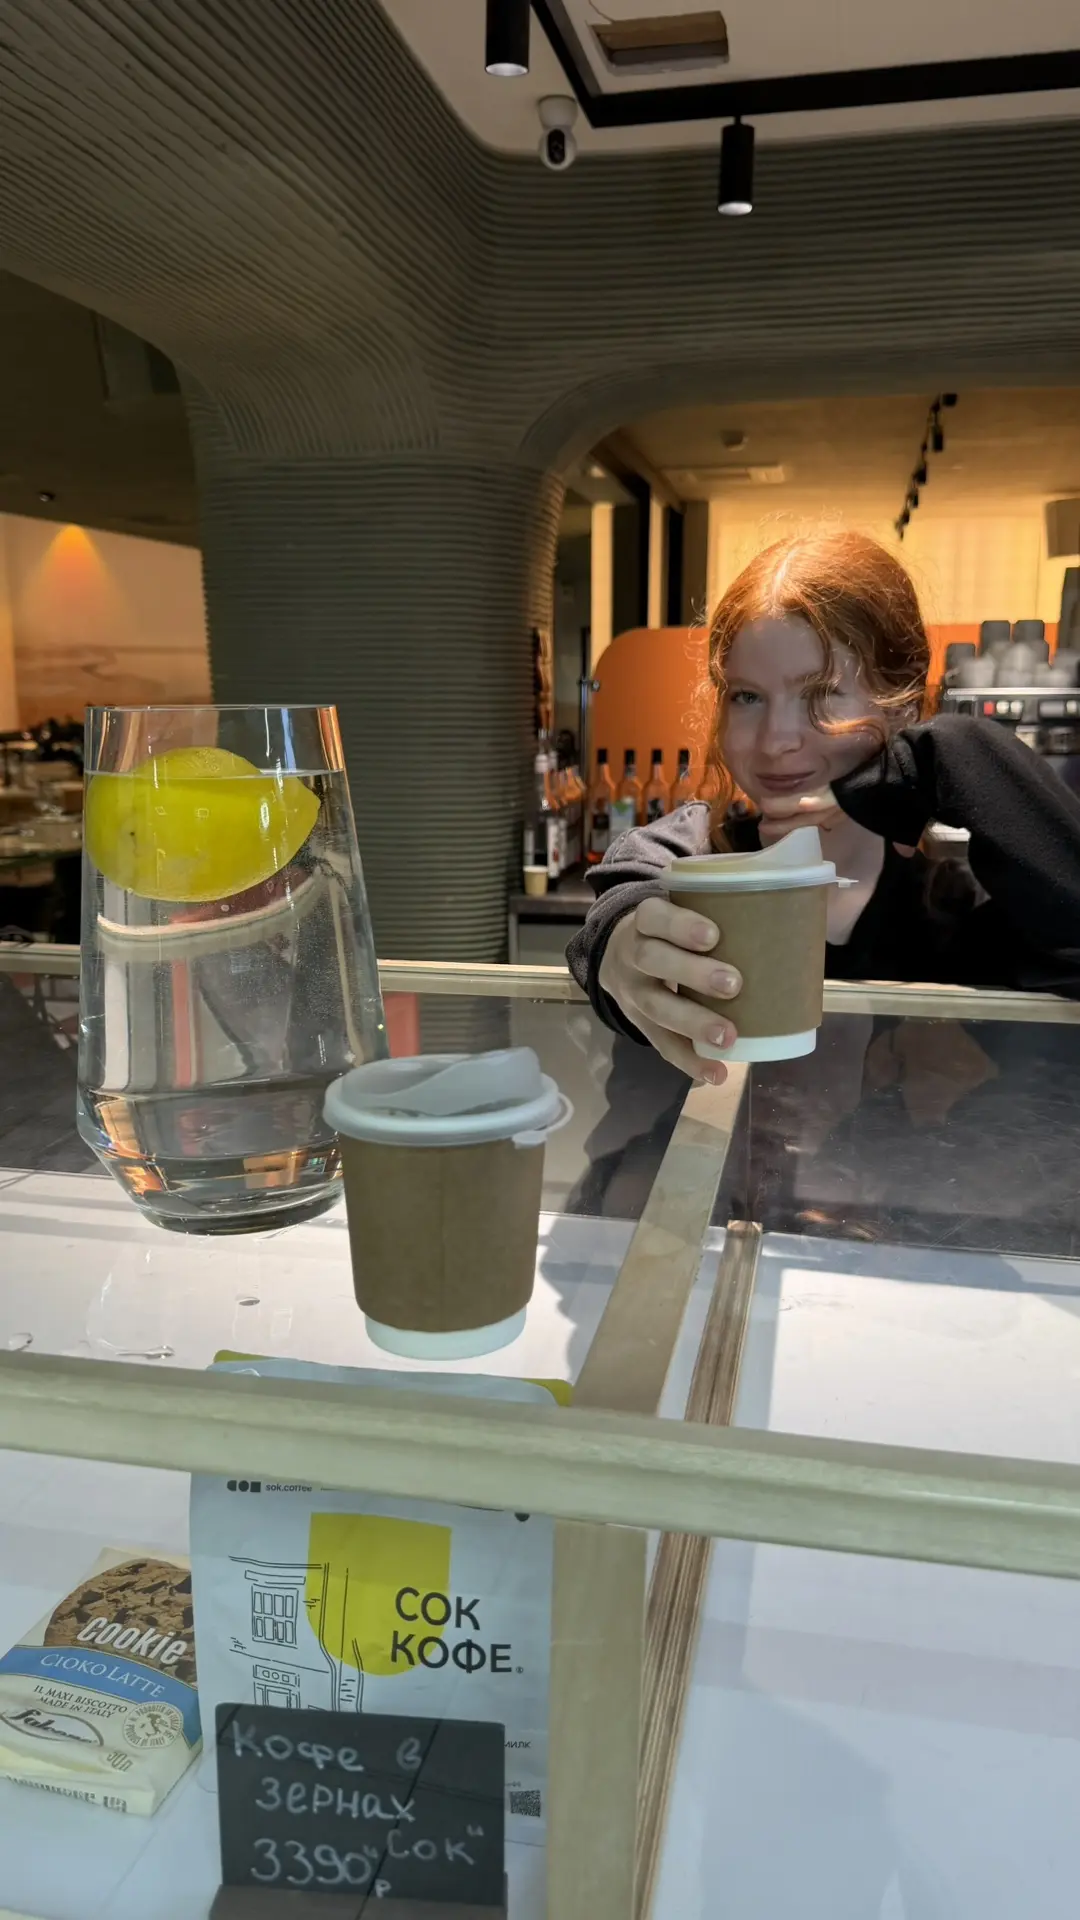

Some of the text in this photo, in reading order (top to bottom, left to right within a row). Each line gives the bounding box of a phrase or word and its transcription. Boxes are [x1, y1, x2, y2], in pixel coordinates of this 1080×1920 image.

[395, 1586, 481, 1631] СОК
[33, 1685, 128, 1713] IL MAXI BISCOTTO
[40, 1697, 116, 1719] MADE IN ITALY
[232, 1720, 364, 1771] Кофе
